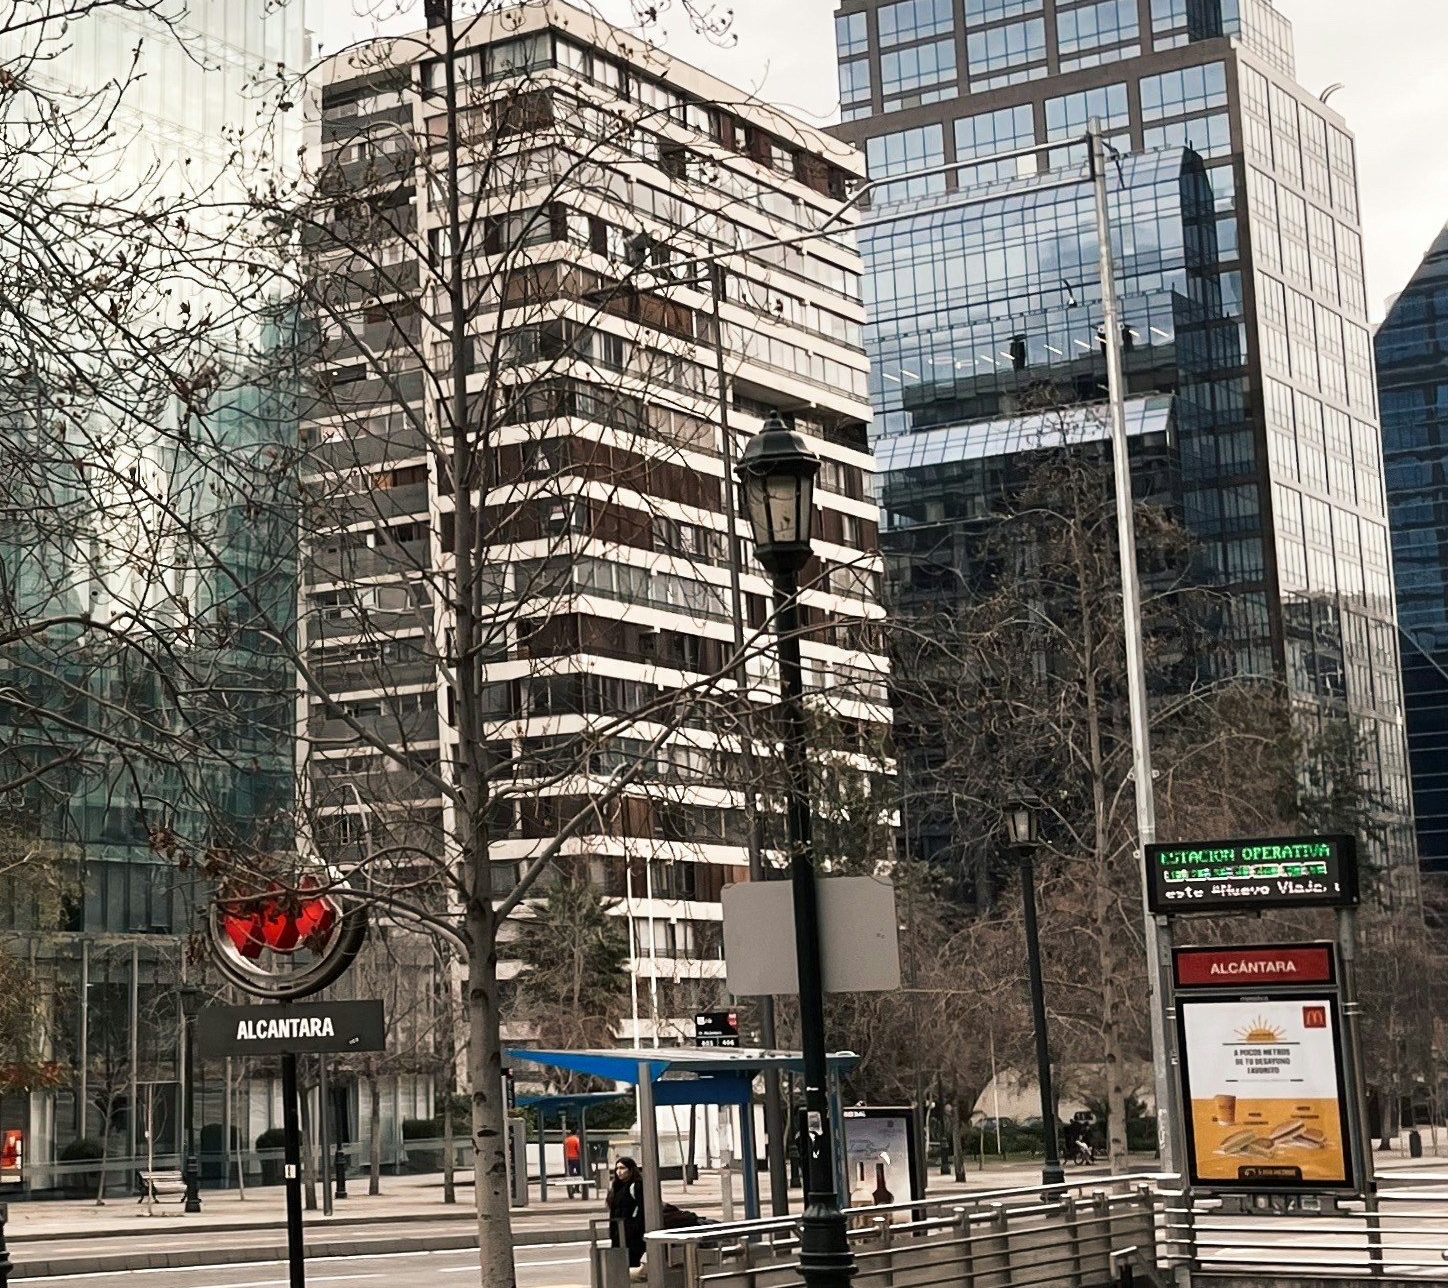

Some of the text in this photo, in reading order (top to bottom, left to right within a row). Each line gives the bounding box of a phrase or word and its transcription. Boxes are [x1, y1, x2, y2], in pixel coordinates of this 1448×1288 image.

[1242, 843, 1330, 861] OPERATIVA
[1210, 959, 1296, 975] ALCÁNTARA
[236, 1017, 335, 1040] ALCANTARA
